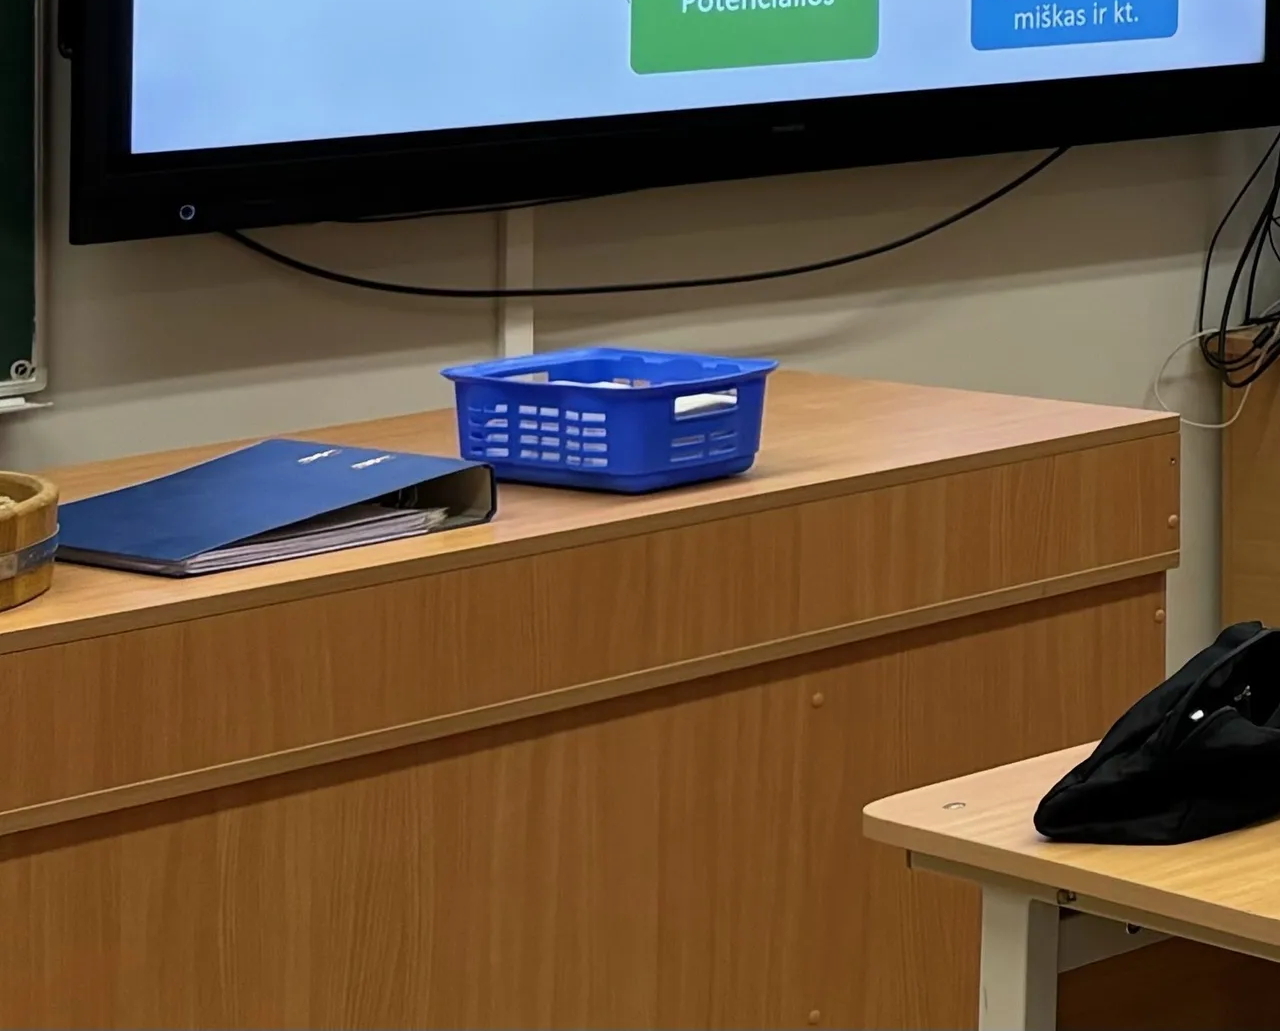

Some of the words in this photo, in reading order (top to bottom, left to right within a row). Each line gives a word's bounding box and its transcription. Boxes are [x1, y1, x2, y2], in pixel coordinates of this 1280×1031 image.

[1013, 3, 1086, 30] miškas
[1093, 2, 1107, 25] ir
[1114, 0, 1139, 23] kt.
